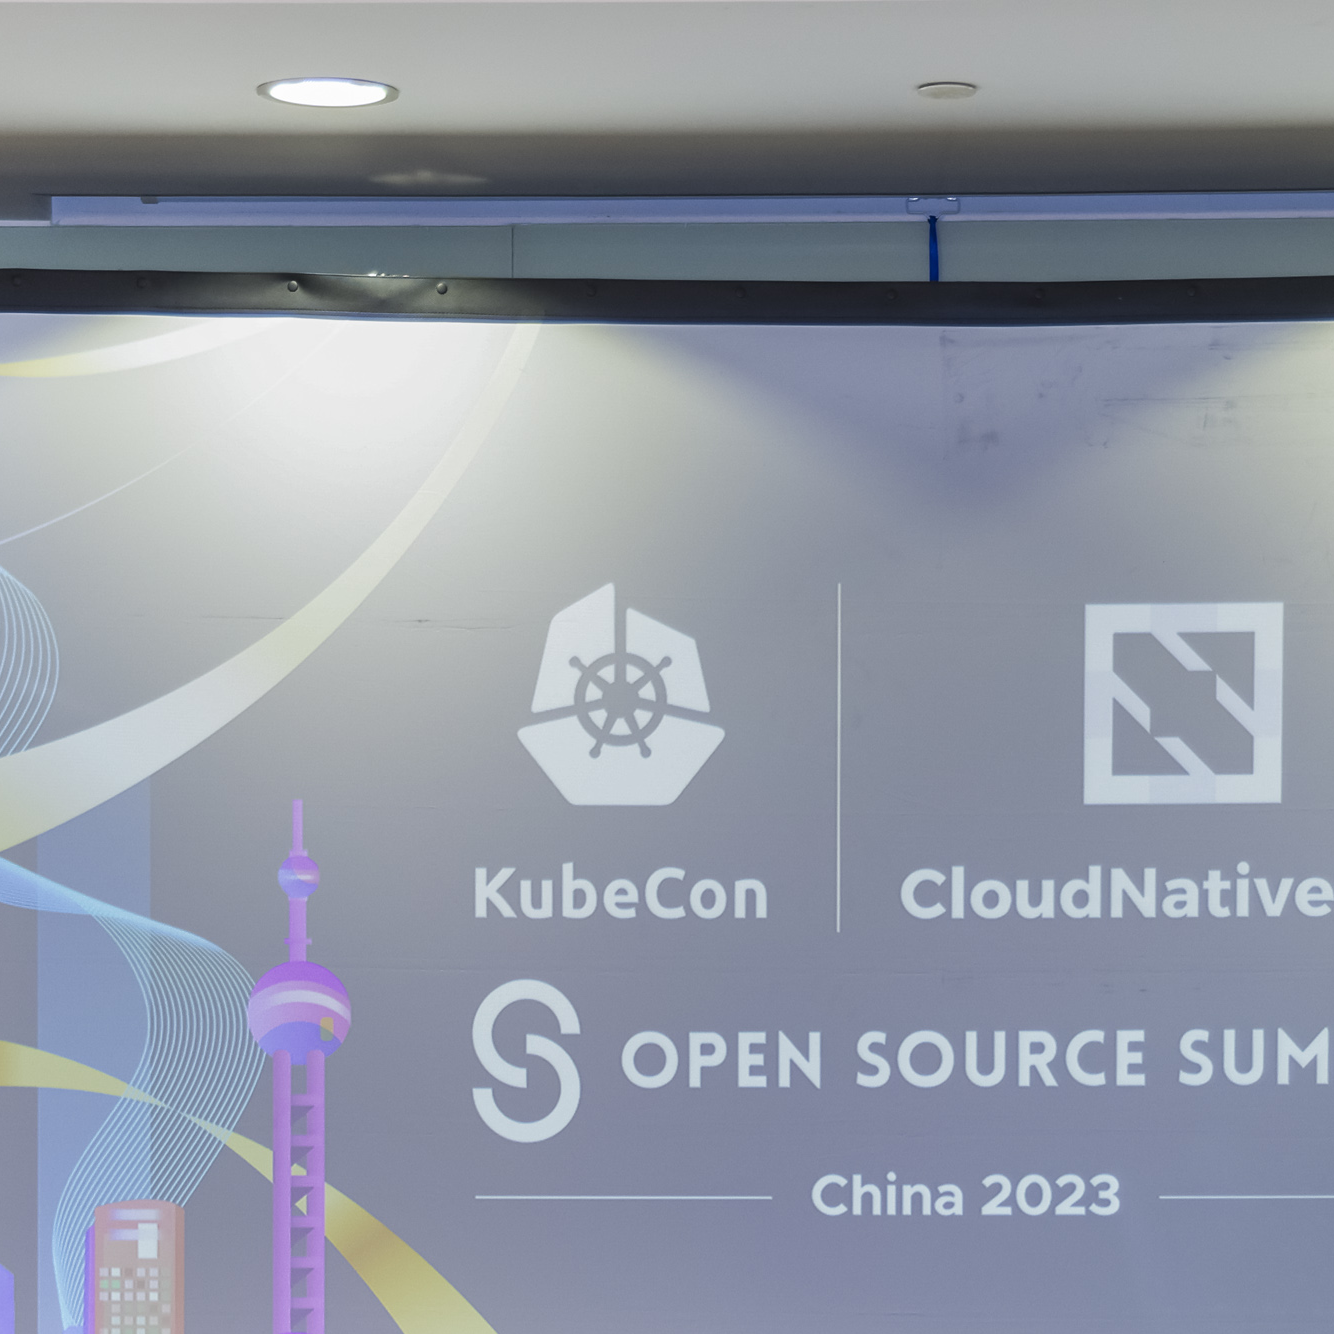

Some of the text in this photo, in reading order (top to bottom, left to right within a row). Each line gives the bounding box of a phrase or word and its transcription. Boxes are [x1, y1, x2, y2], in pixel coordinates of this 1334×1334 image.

[474, 862, 768, 919] KubeCon
[621, 1031, 821, 1089] OPEN
[856, 1030, 1146, 1088] SOURCE
[812, 1172, 1121, 1216] China 2023
